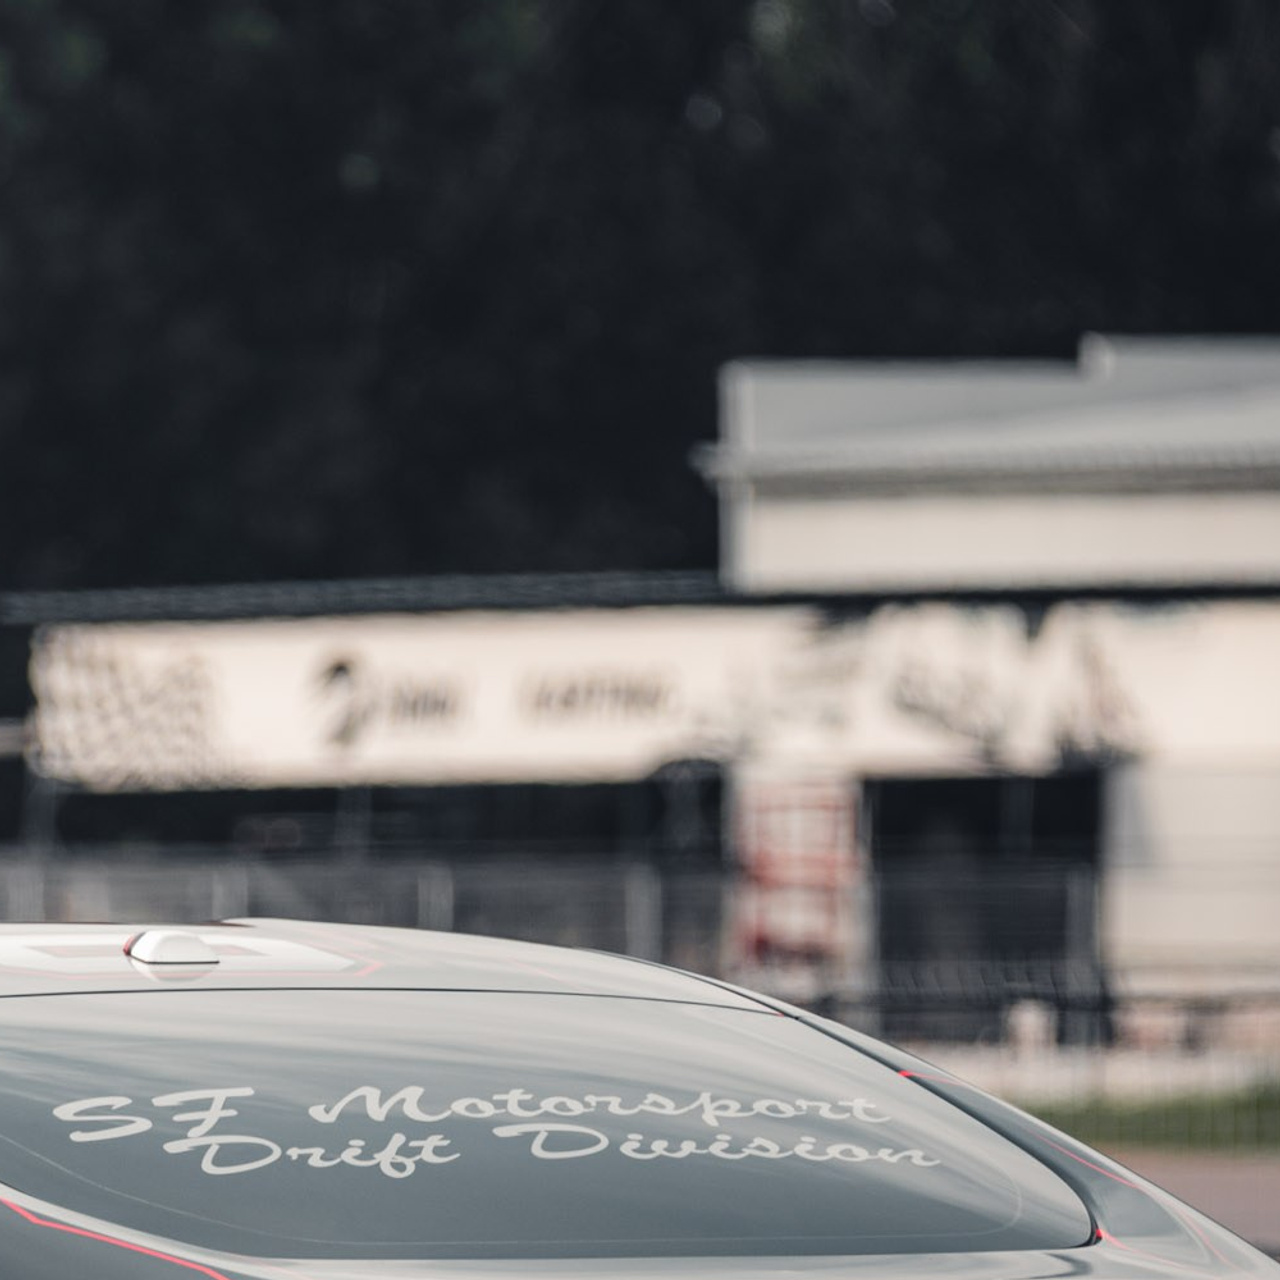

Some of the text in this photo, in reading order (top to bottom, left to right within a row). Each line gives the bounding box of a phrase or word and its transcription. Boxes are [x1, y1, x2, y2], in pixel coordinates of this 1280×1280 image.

[53, 1086, 891, 1143] SF Motorsport
[163, 1122, 942, 1179] Drift Division
